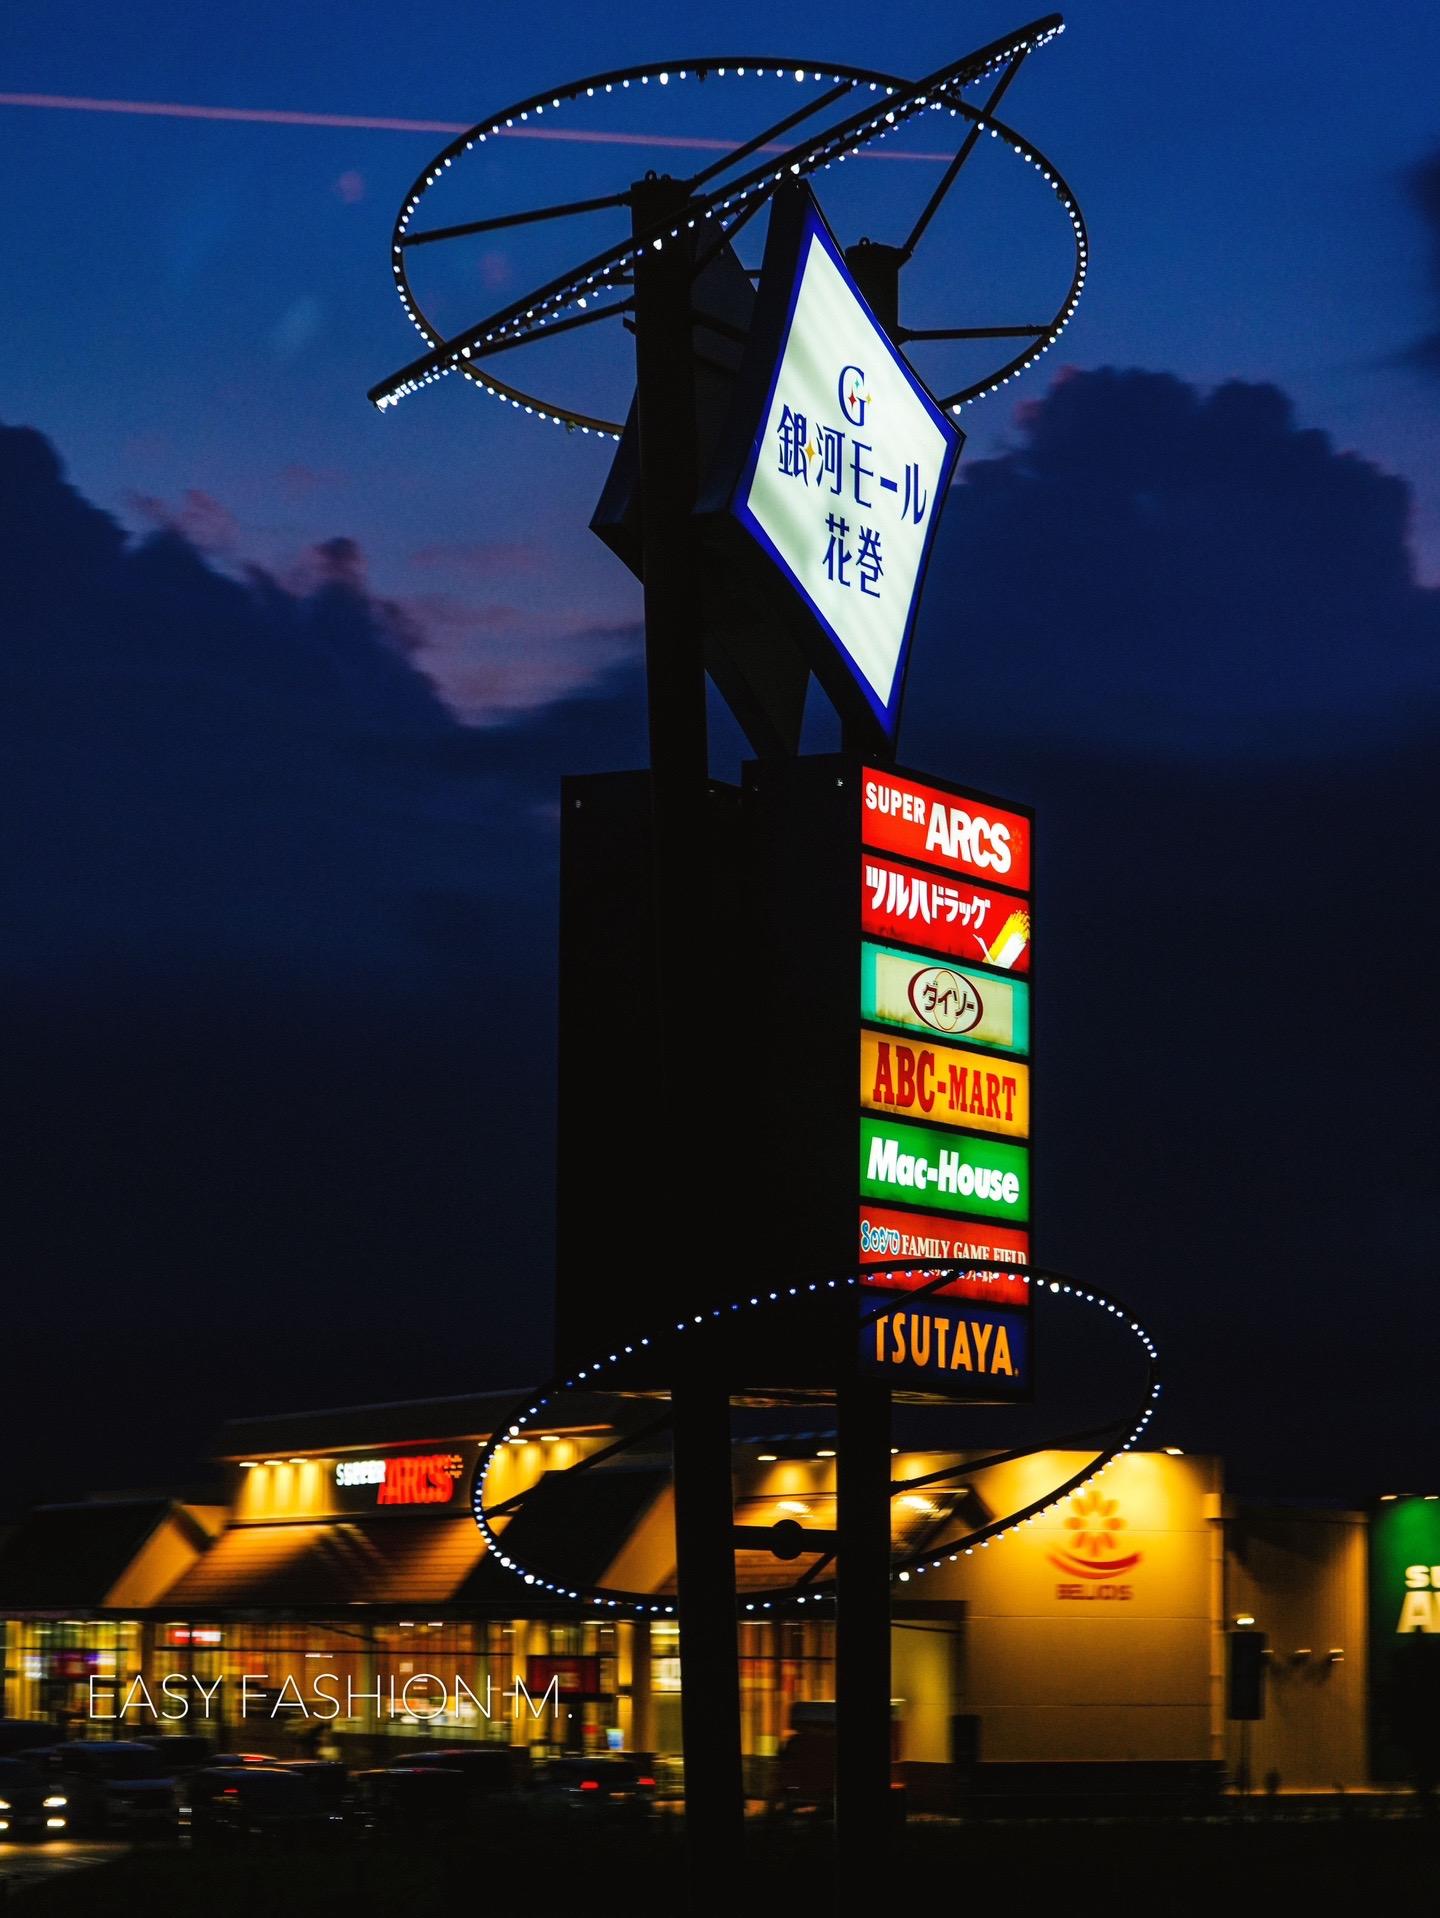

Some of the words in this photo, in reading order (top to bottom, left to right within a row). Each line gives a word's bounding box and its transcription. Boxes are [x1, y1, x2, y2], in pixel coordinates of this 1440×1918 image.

[776, 403, 927, 526] 銀河モール
[822, 511, 884, 599] 花巻
[865, 781, 926, 826] SUPER
[925, 801, 1012, 874] ARCS
[865, 864, 991, 930] ツルハドラッグ
[923, 981, 975, 1017] ダイソー
[873, 1041, 1016, 1122] ABC-MART
[866, 1136, 1020, 1204] Mac-House
[901, 1234, 950, 1259] FAMILY
[953, 1241, 990, 1260] GAME
[993, 1247, 1027, 1265] FIELD
[876, 1312, 1014, 1376] TSUTAYA
